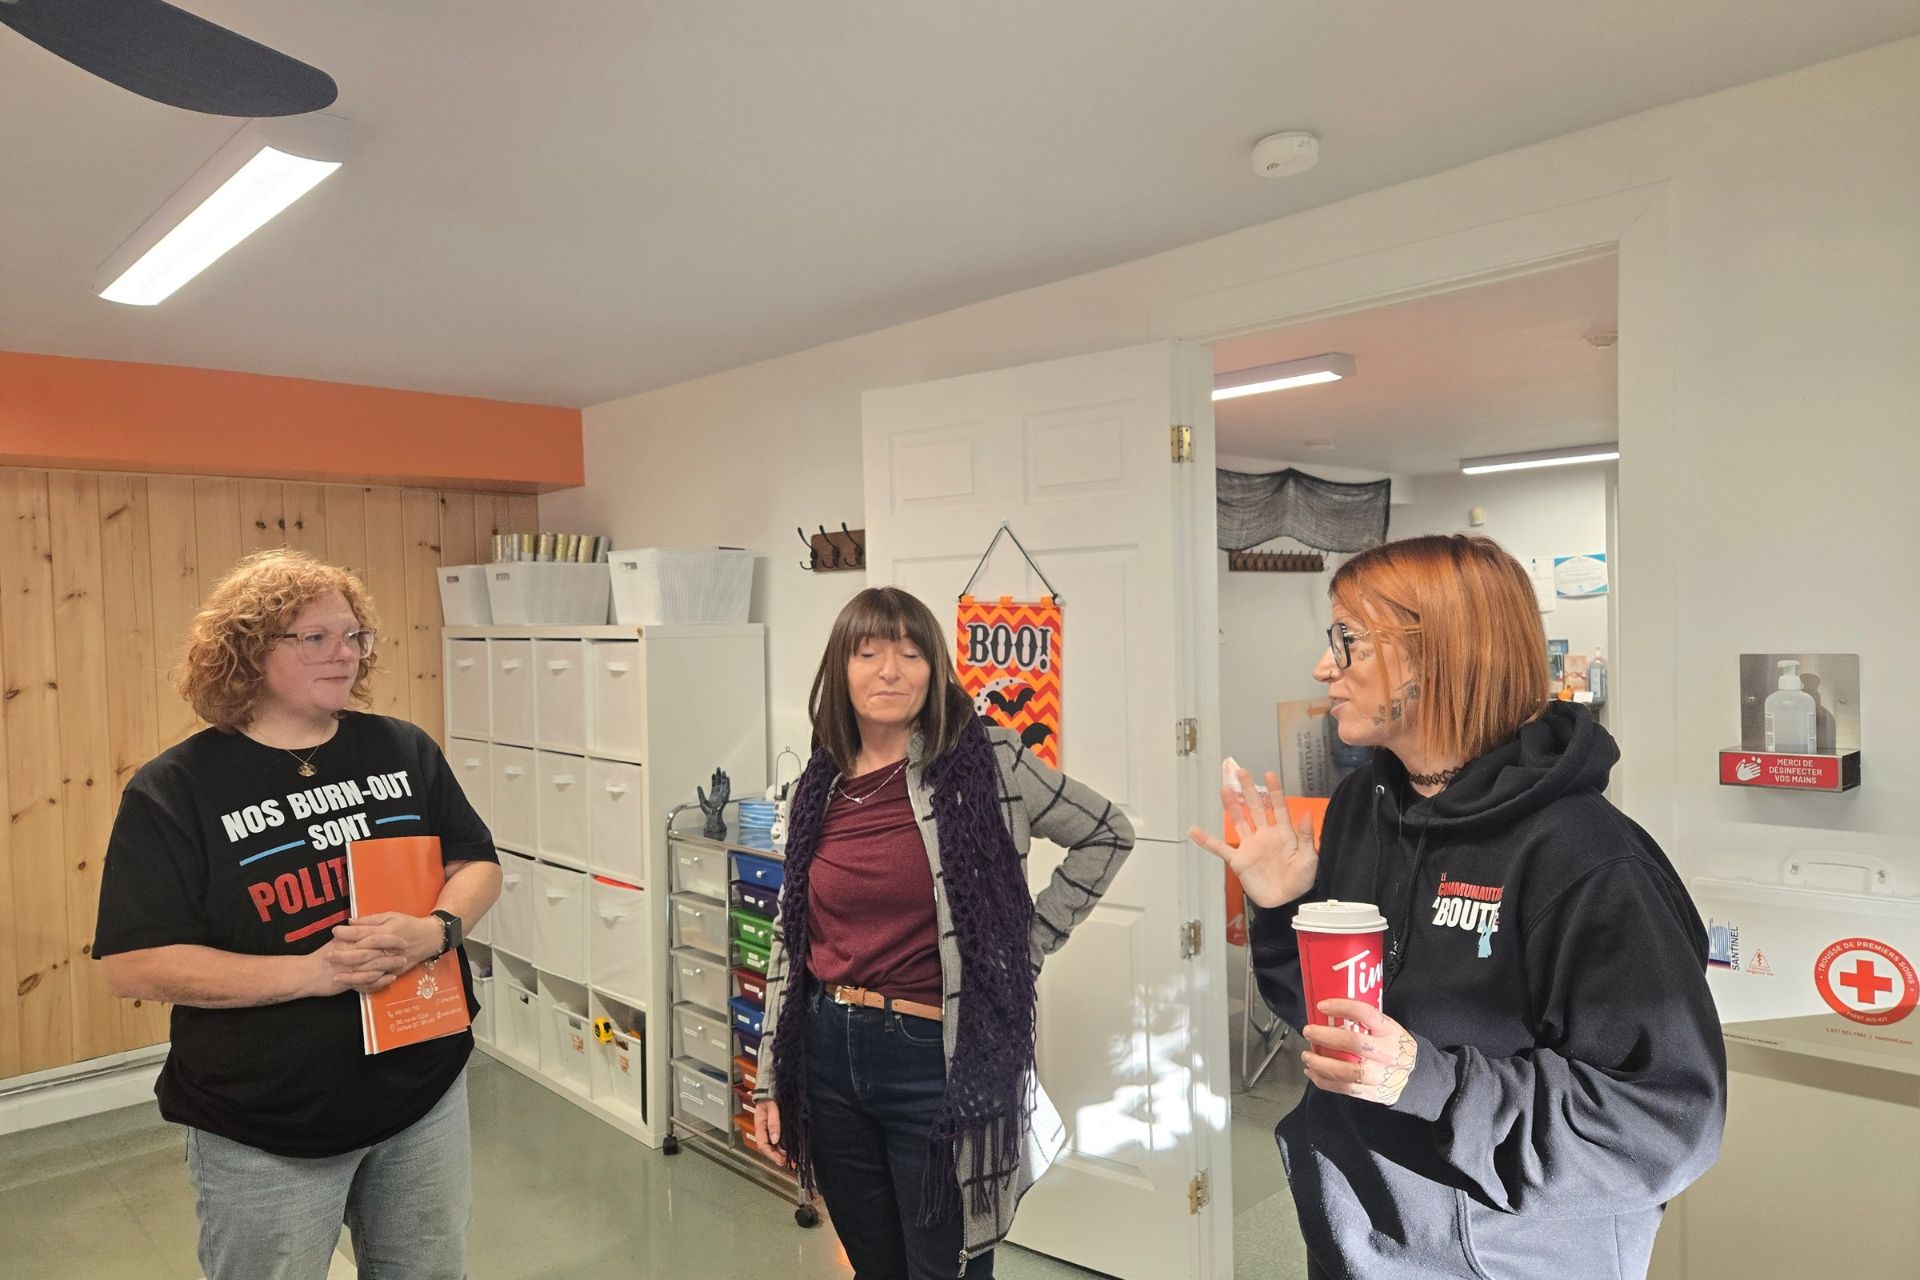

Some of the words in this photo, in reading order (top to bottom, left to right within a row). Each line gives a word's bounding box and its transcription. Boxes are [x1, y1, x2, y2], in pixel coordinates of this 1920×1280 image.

[966, 623, 1052, 671] BOO!
[1777, 759, 1801, 767] MERCI
[1792, 776, 1816, 784] MAINS
[221, 799, 285, 843] NOS
[286, 770, 413, 820] BURN-OUT
[308, 812, 371, 850] SONT
[248, 855, 350, 922] POLIT
[1440, 873, 1447, 881] LE
[1731, 926, 1739, 971] SANTINEL
[1818, 945, 1843, 972] TROUSSE
[1843, 941, 1855, 949] DE
[1856, 941, 1901, 962] PREMIERS
[1899, 961, 1916, 985] SOINS
[1846, 1010, 1864, 1021] FIRST
